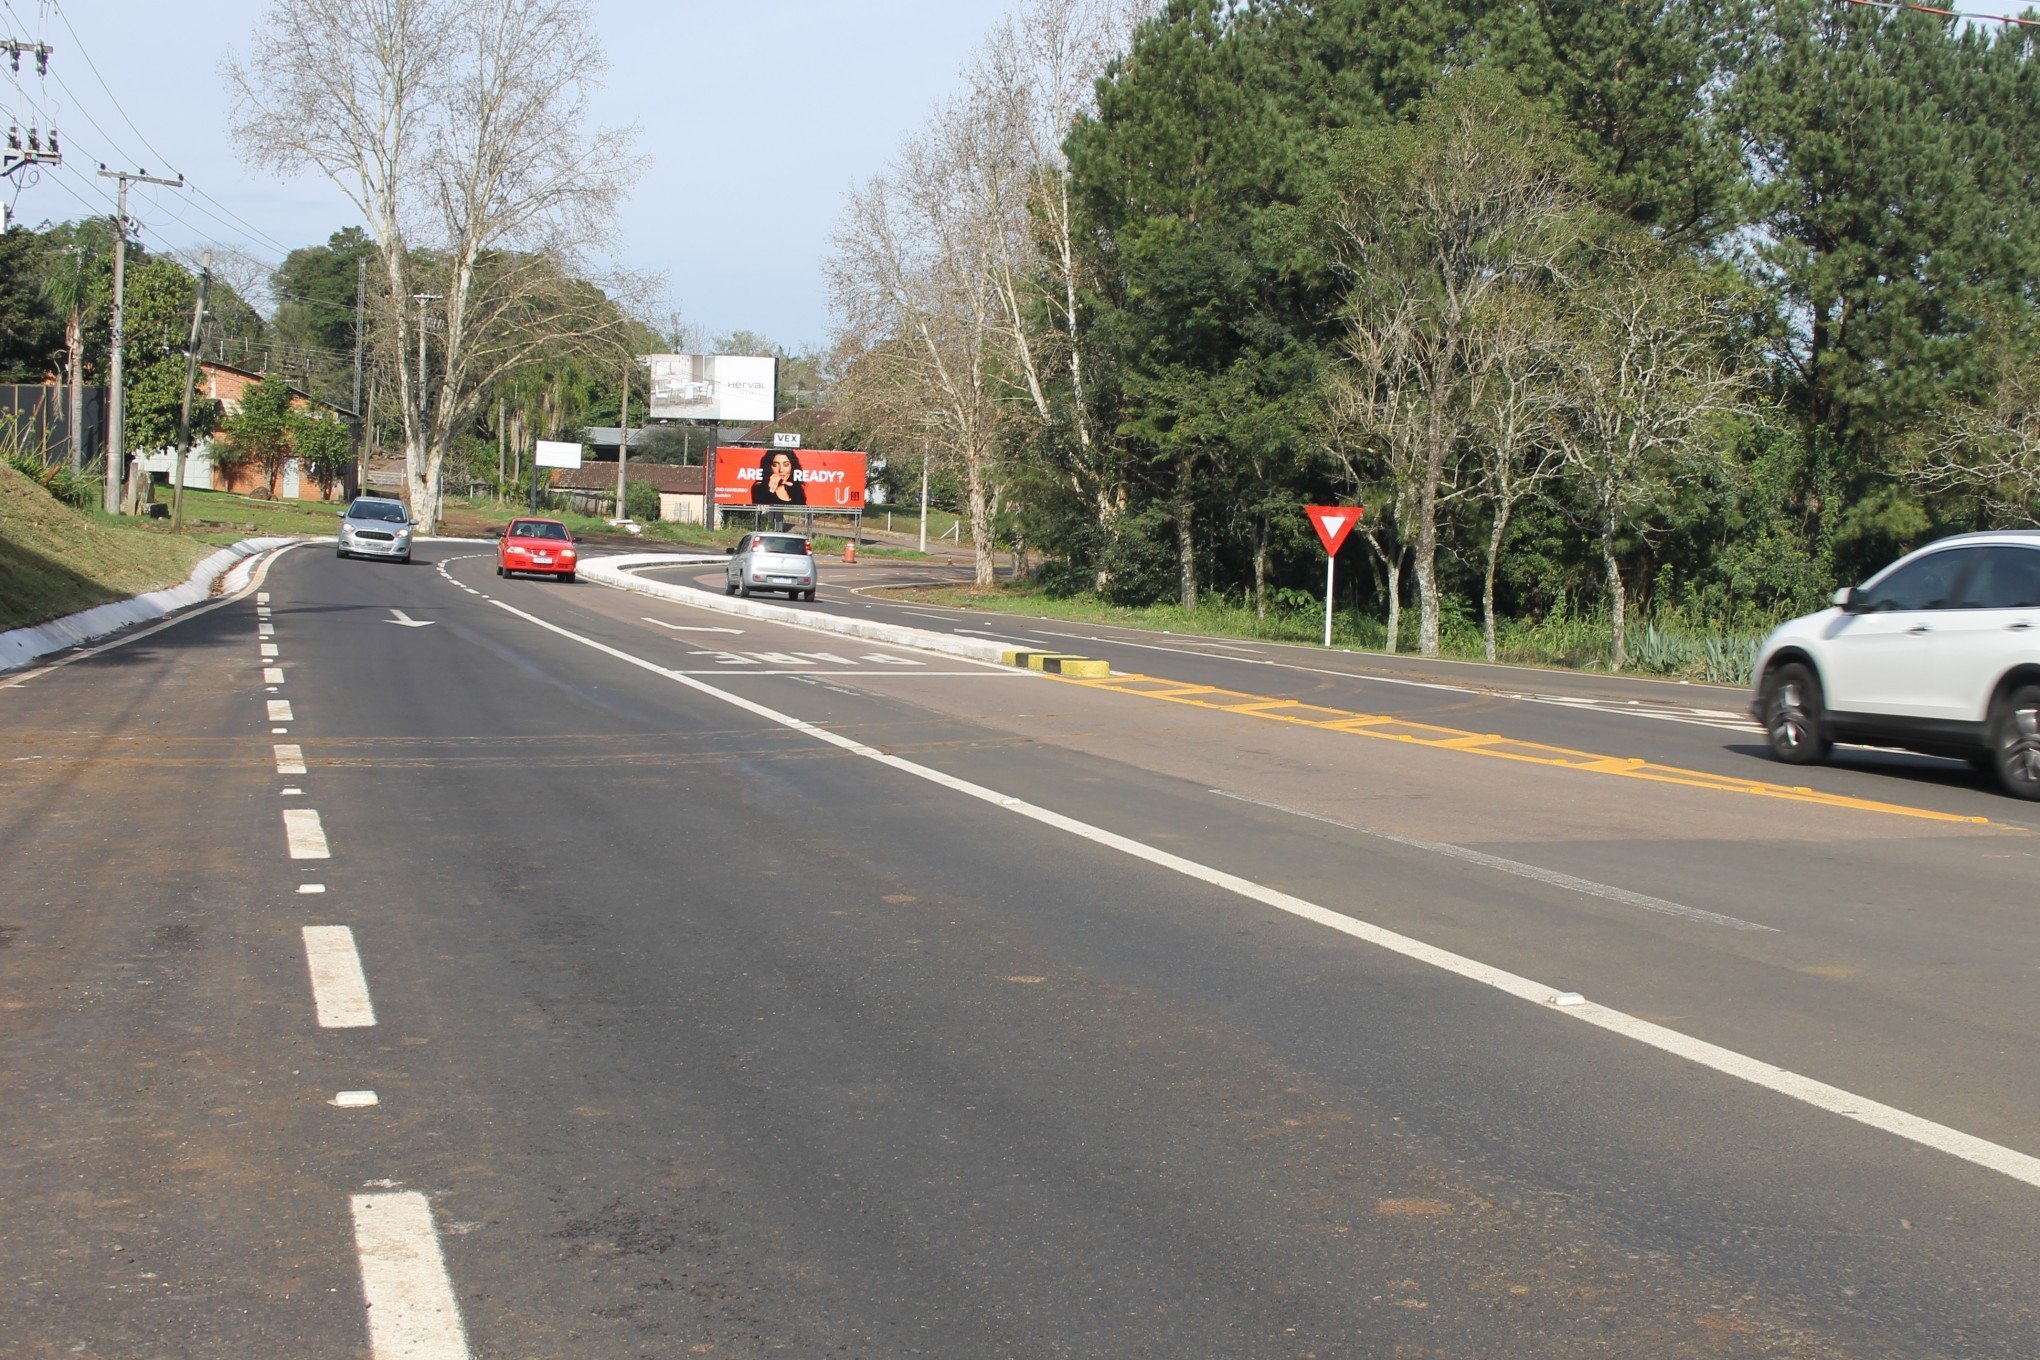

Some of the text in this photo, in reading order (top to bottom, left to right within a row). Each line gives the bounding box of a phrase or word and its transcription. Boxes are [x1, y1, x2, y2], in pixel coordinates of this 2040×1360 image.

[777, 434, 797, 443] VEX
[737, 467, 845, 483] ARE READY?
